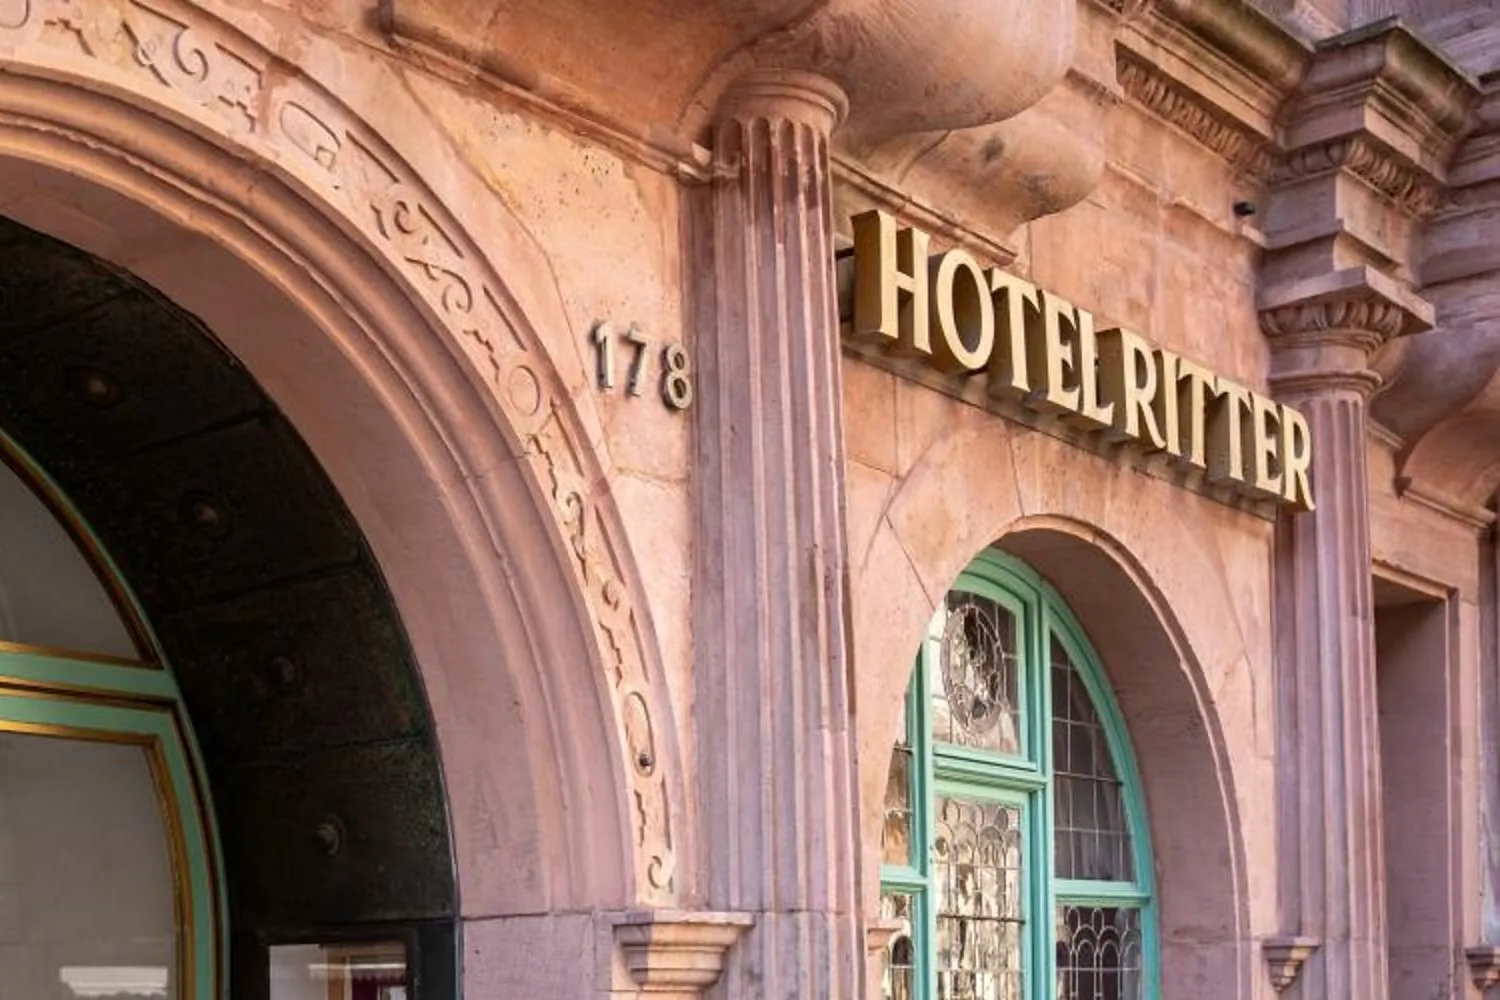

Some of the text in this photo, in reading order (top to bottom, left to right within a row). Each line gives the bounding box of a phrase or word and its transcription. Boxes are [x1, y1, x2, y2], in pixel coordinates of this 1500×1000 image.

[587, 319, 693, 412] 178
[872, 209, 1316, 511] HOTEL RITTER
